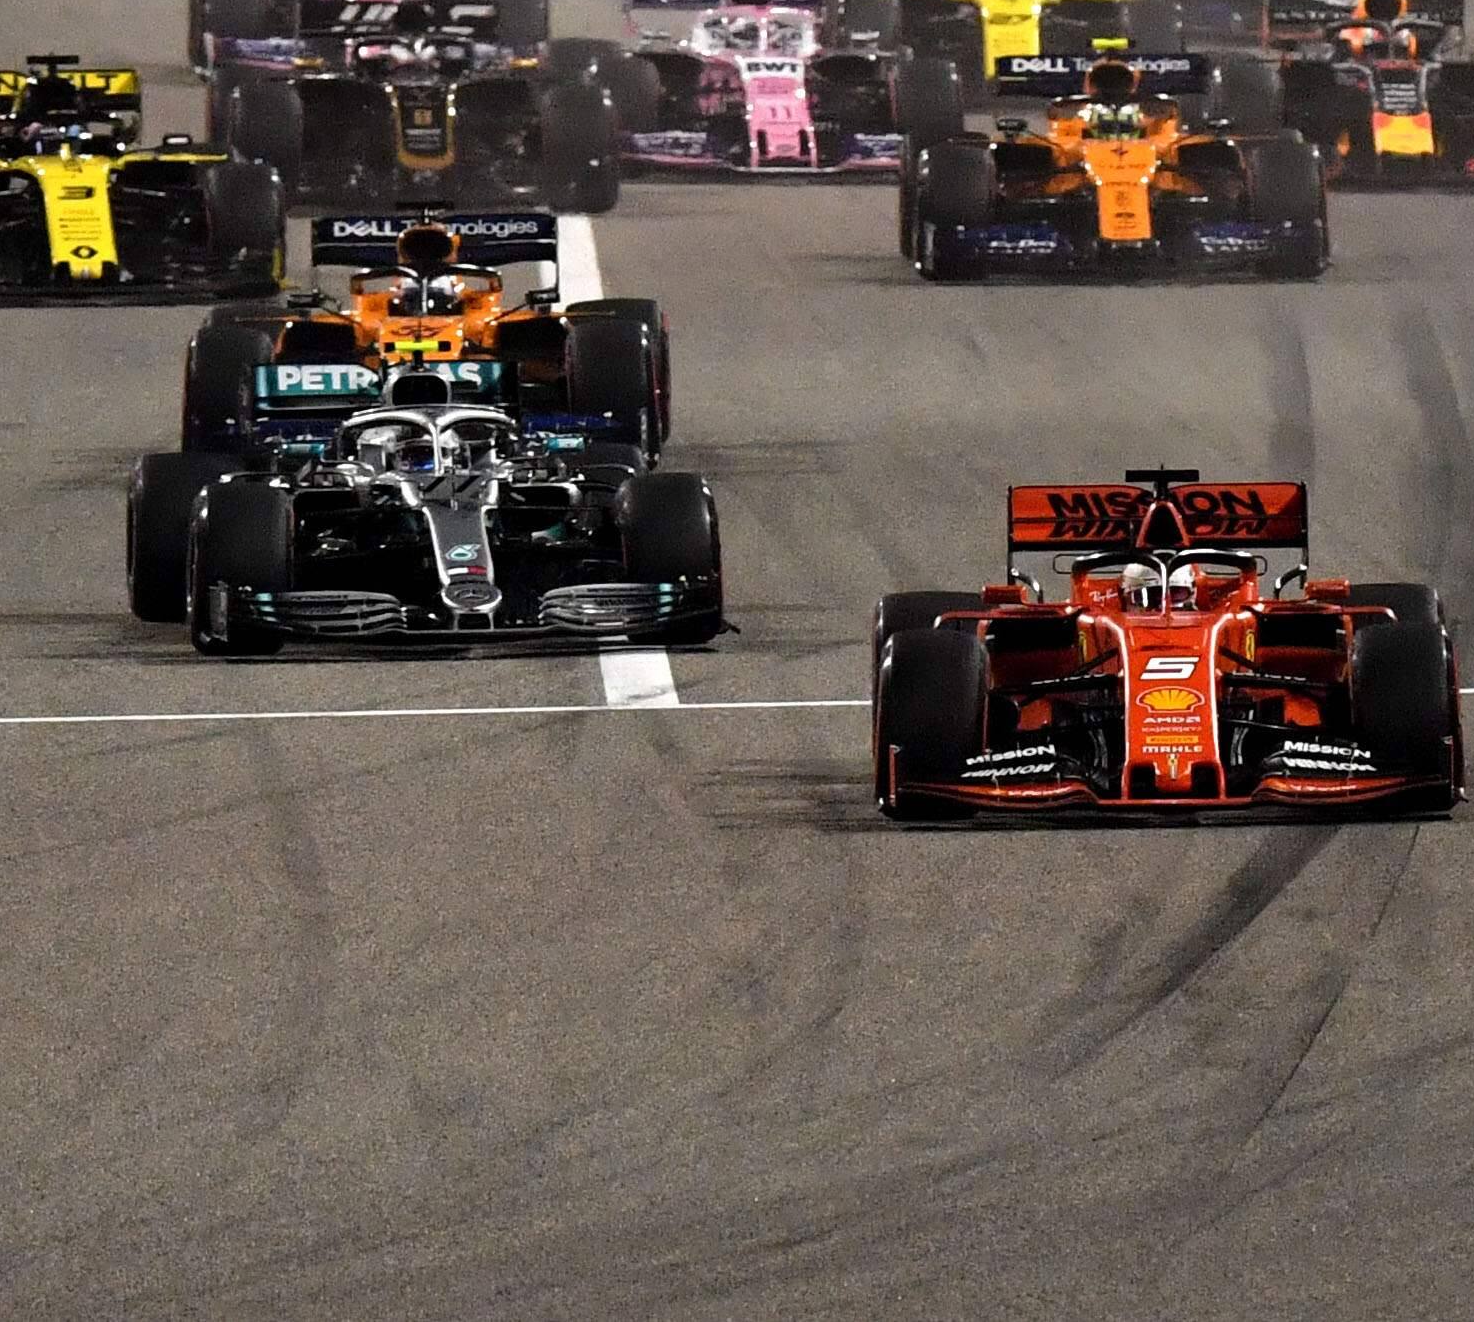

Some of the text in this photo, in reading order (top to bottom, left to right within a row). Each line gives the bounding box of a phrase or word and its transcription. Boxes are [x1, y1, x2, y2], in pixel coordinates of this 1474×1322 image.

[747, 62, 798, 73] BWT
[1011, 57, 1070, 73] DELL
[57, 186, 96, 200] 3
[333, 219, 398, 237] DELL
[1139, 657, 1200, 680] 5
[1142, 716, 1186, 724] AMD
[966, 744, 1055, 766] MISSION
[1284, 740, 1371, 758] MISSION
